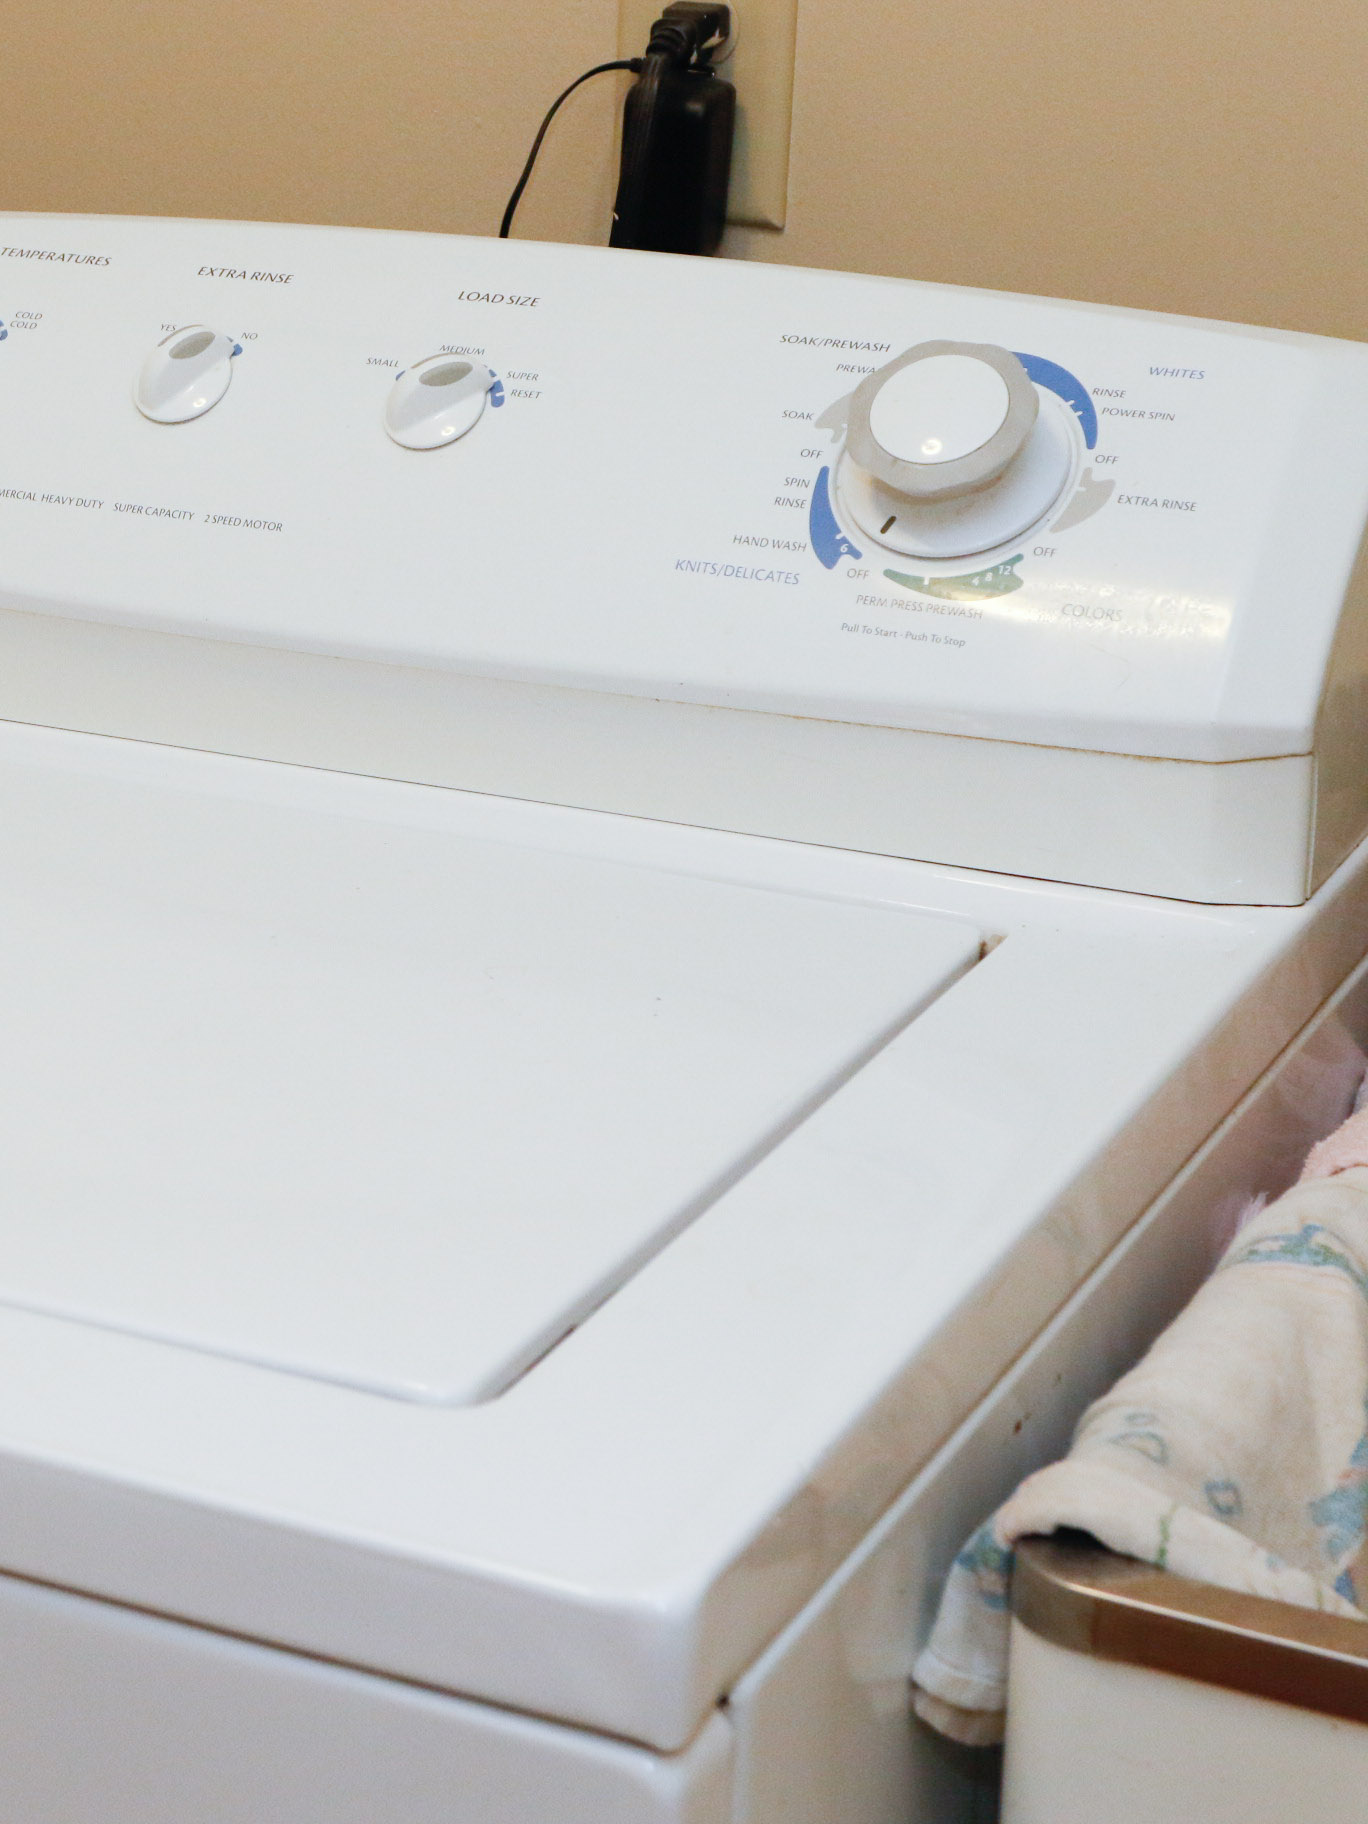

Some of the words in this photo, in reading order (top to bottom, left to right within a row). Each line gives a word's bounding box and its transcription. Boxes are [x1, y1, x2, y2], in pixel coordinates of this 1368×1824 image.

[0, 246, 112, 267] TEMPERATURES
[198, 266, 246, 280] EXTRA
[250, 271, 294, 284] RINSE
[458, 290, 504, 304] LOAD
[506, 295, 541, 307] SIZE
[15, 311, 43, 320] COLD
[10, 321, 38, 330] COLD
[160, 324, 176, 332] YES
[241, 332, 258, 340] NO
[780, 334, 890, 352] SOAK/PREWASH
[440, 344, 485, 355] MEDIUM
[366, 357, 400, 367] SMALL
[836, 364, 876, 374] PREWA
[1149, 366, 1206, 380] WHITES
[506, 371, 539, 381] SUPER
[510, 389, 542, 399] RESET
[1092, 388, 1126, 398] RINSE
[782, 410, 814, 420] SOAK
[1102, 407, 1144, 419] POWER
[1148, 411, 1176, 421] SPIN
[800, 449, 824, 459] OFF
[1095, 454, 1119, 464] OFF
[784, 477, 810, 488] SPIN
[774, 497, 807, 508] RINSE
[1118, 494, 1158, 507] EXTRA
[1162, 499, 1198, 512] RINSE
[41, 494, 74, 506] HEAVY
[76, 498, 104, 510] DUTY
[113, 502, 144, 514] SUPER
[145, 506, 195, 520] CAPACITY
[204, 514, 210, 523] 2
[212, 515, 242, 526] SPEED
[243, 520, 283, 532] MOTOR
[732, 535, 768, 547] HAND
[772, 540, 807, 552] WASH
[840, 544, 848, 552] 6
[1033, 546, 1056, 557] OFF
[675, 559, 800, 585] KNITS/DELICATES
[847, 568, 870, 580] OFF
[999, 565, 1012, 575] 12
[856, 594, 888, 607] PERM
[890, 599, 922, 612] PRESS
[926, 603, 983, 619] PREWASH
[1061, 603, 1122, 622] COLORS
[841, 622, 858, 632] Pull
[861, 626, 872, 635] To
[875, 626, 898, 637] Start
[905, 631, 928, 642] Push
[932, 634, 942, 643] To
[944, 636, 966, 648] Stop
